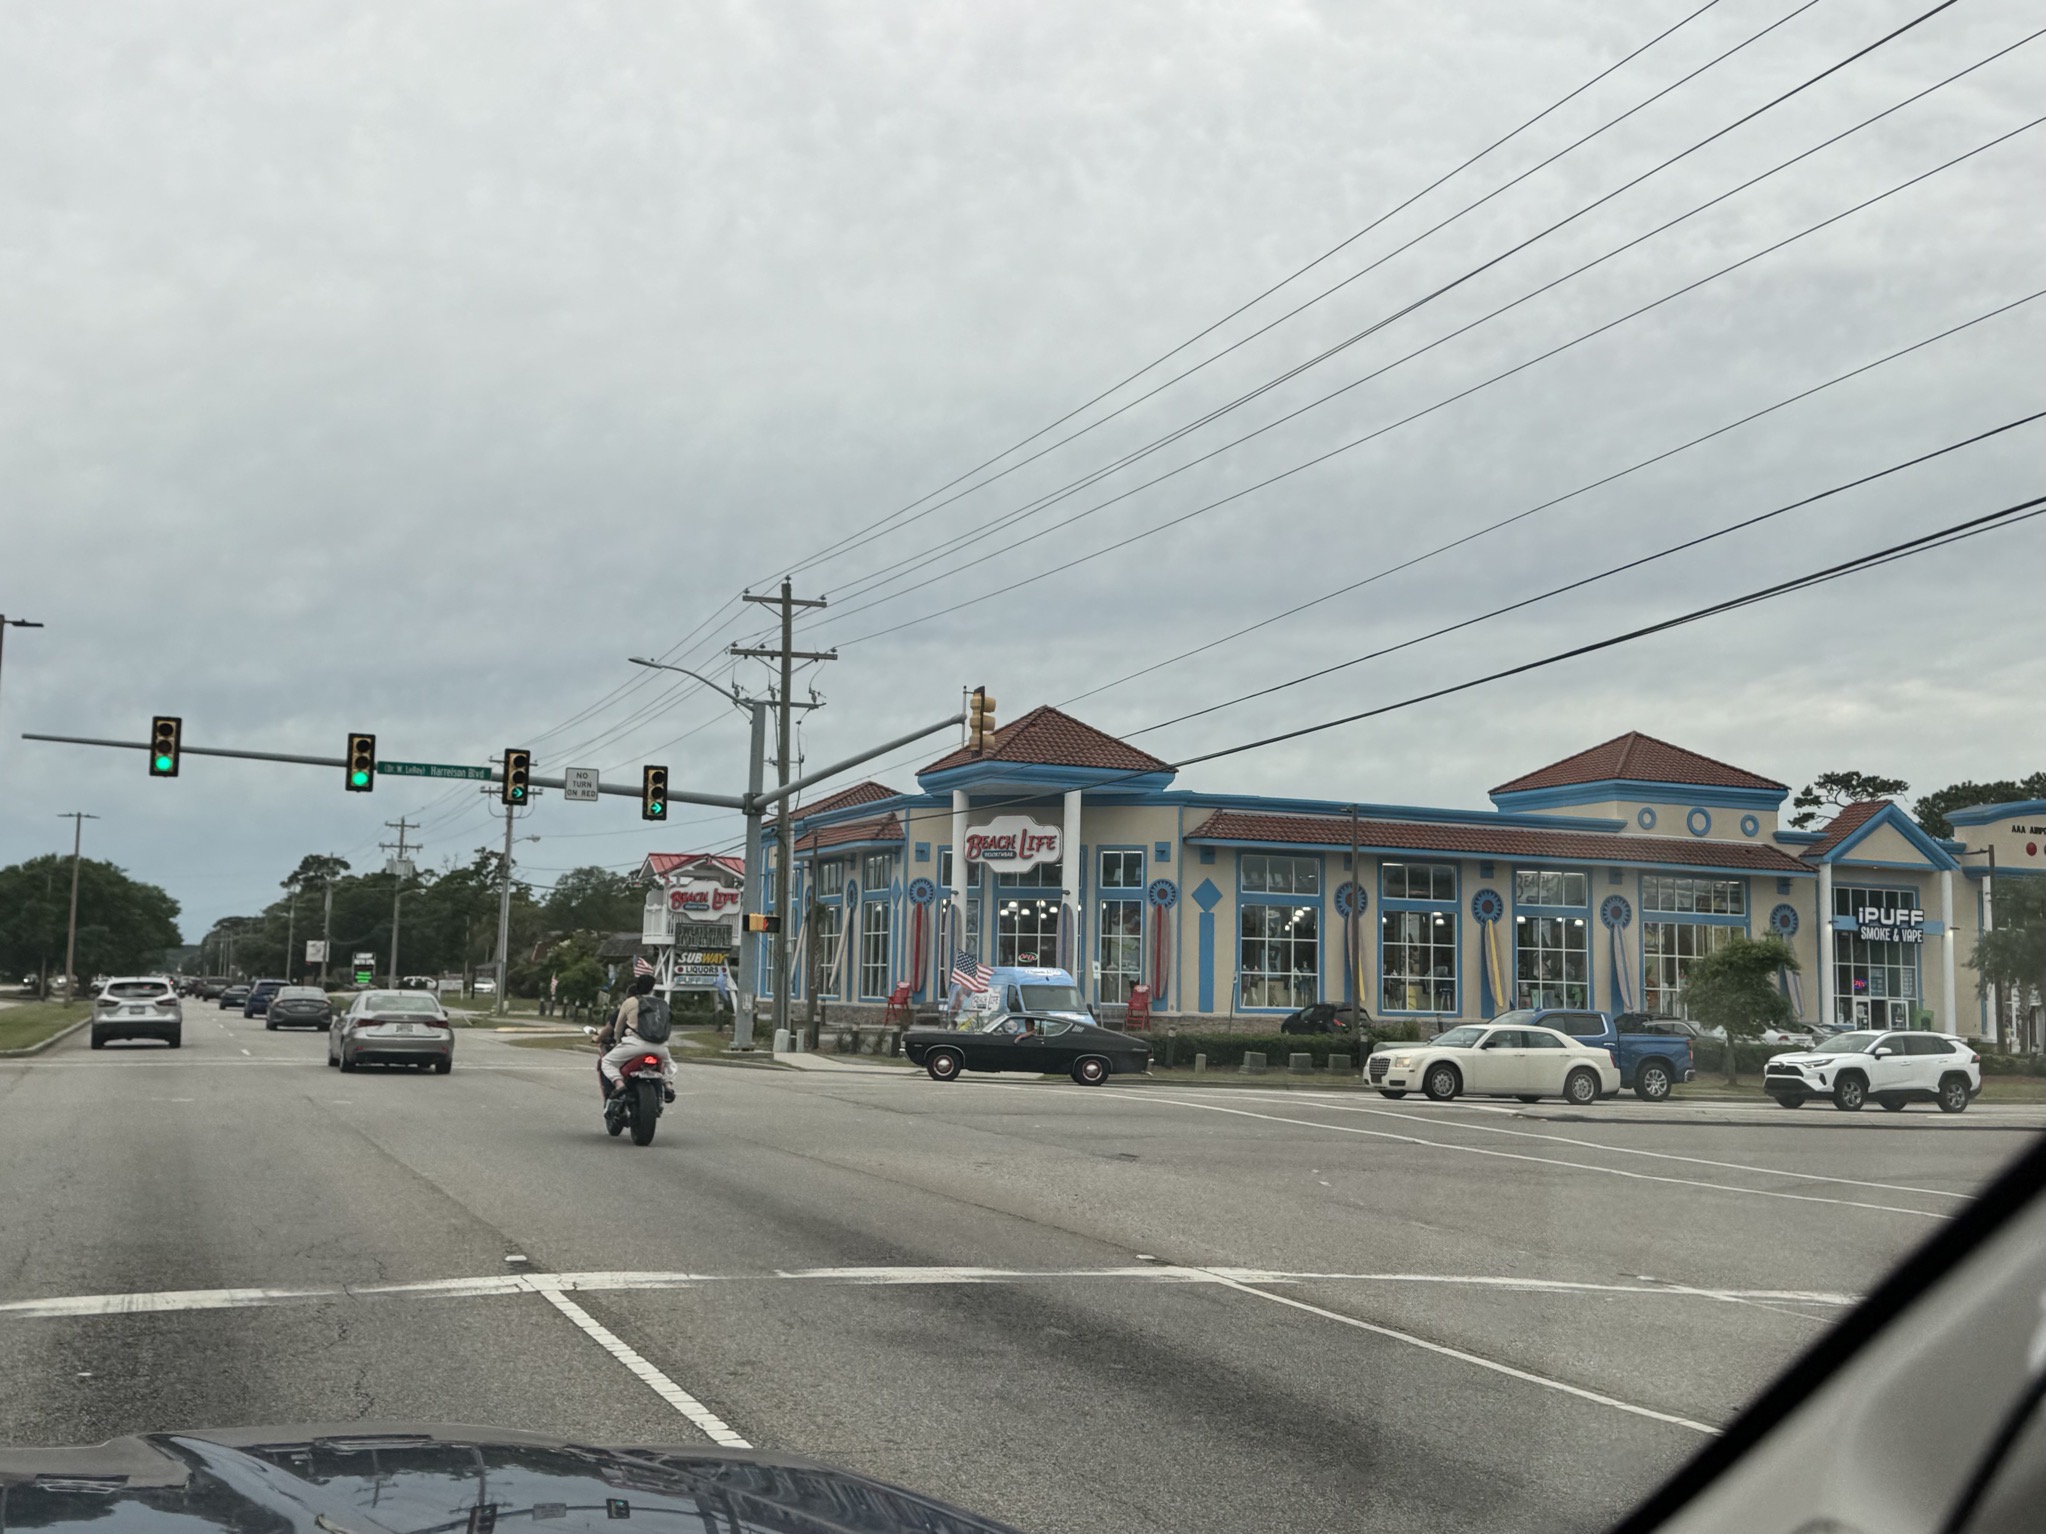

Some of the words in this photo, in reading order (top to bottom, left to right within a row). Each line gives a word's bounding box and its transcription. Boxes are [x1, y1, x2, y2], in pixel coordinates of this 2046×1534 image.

[430, 766, 466, 778] Harrelson
[468, 768, 485, 779] Blvd
[576, 772, 589, 780] NO
[2012, 825, 2026, 834] AAA
[966, 833, 1017, 860] BEACH
[1018, 828, 1058, 860] LIFE
[669, 890, 709, 911] BEACH
[711, 888, 740, 911] LIFE
[1858, 906, 1924, 927] iPUFF
[1860, 926, 1891, 941] SMOKE
[1892, 928, 1900, 942] &
[1901, 928, 1923, 943] VAPE
[677, 952, 726, 964] SUBWAY
[685, 966, 719, 974] LIQUORS
